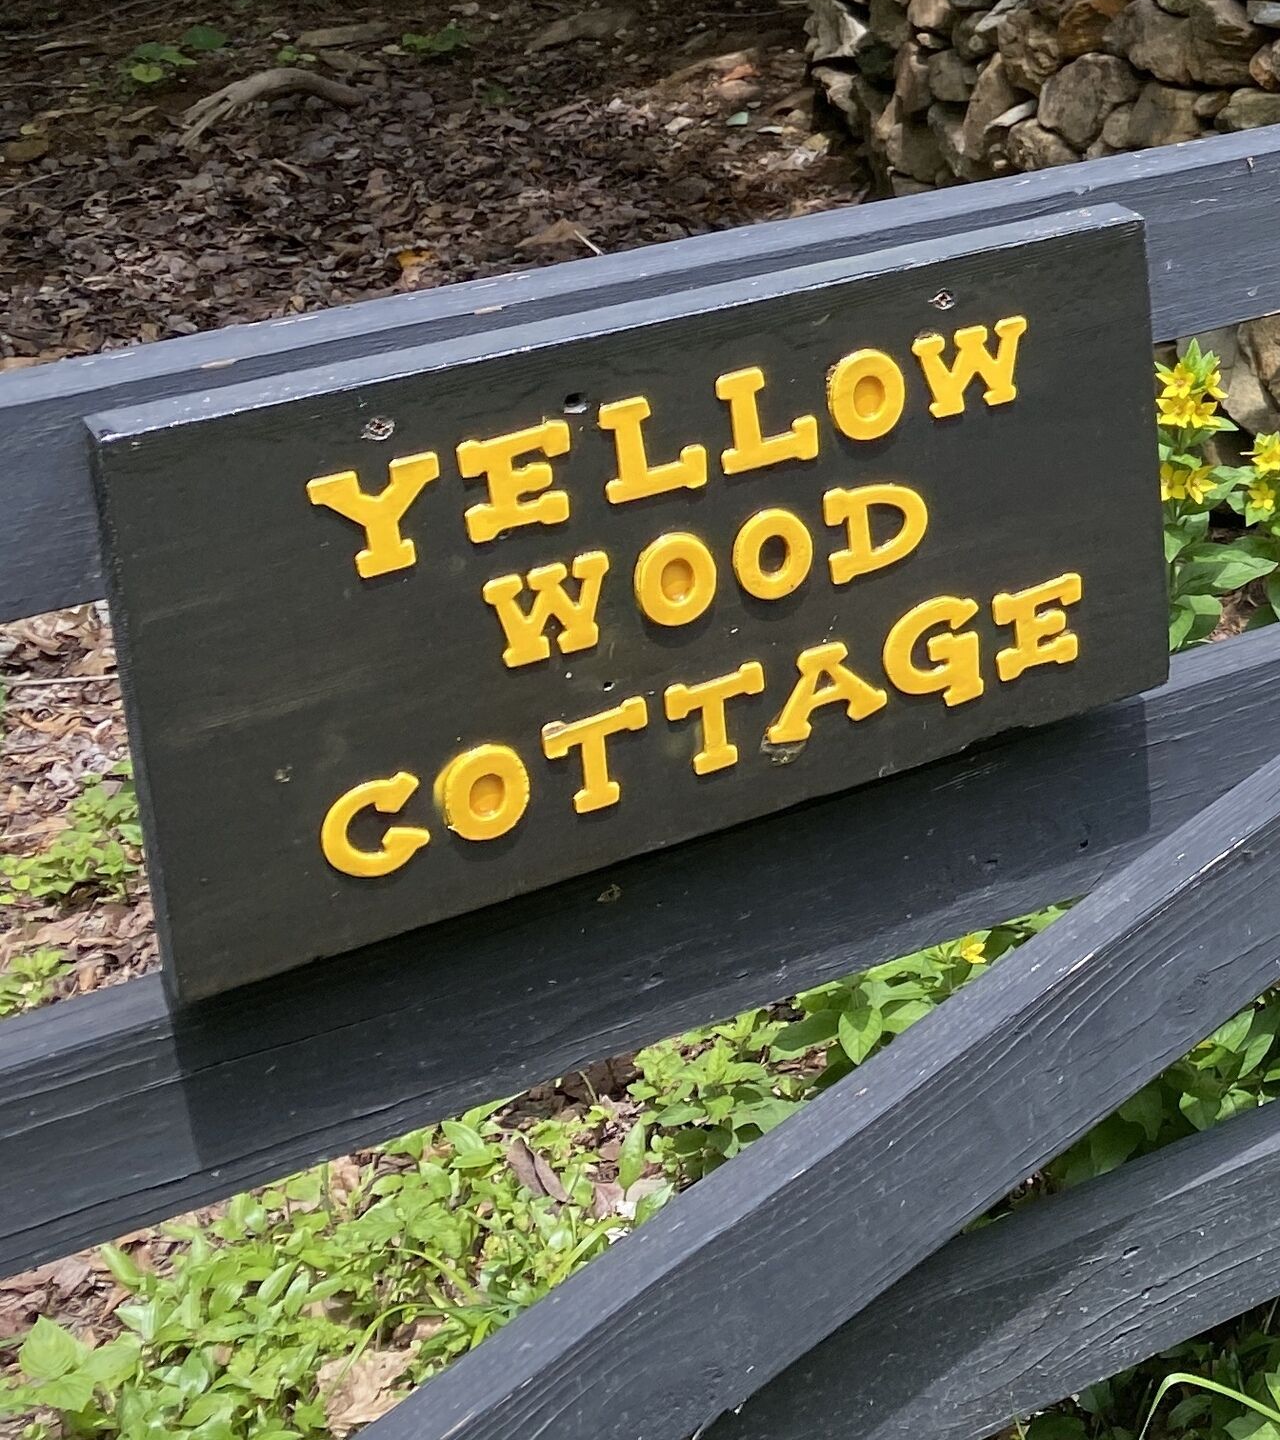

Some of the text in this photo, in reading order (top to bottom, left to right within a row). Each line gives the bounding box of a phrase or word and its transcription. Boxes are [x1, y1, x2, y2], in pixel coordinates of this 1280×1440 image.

[306, 316, 1028, 578] YELLOW
[482, 483, 929, 668] WOOD
[320, 572, 1083, 878] COTTAGE
